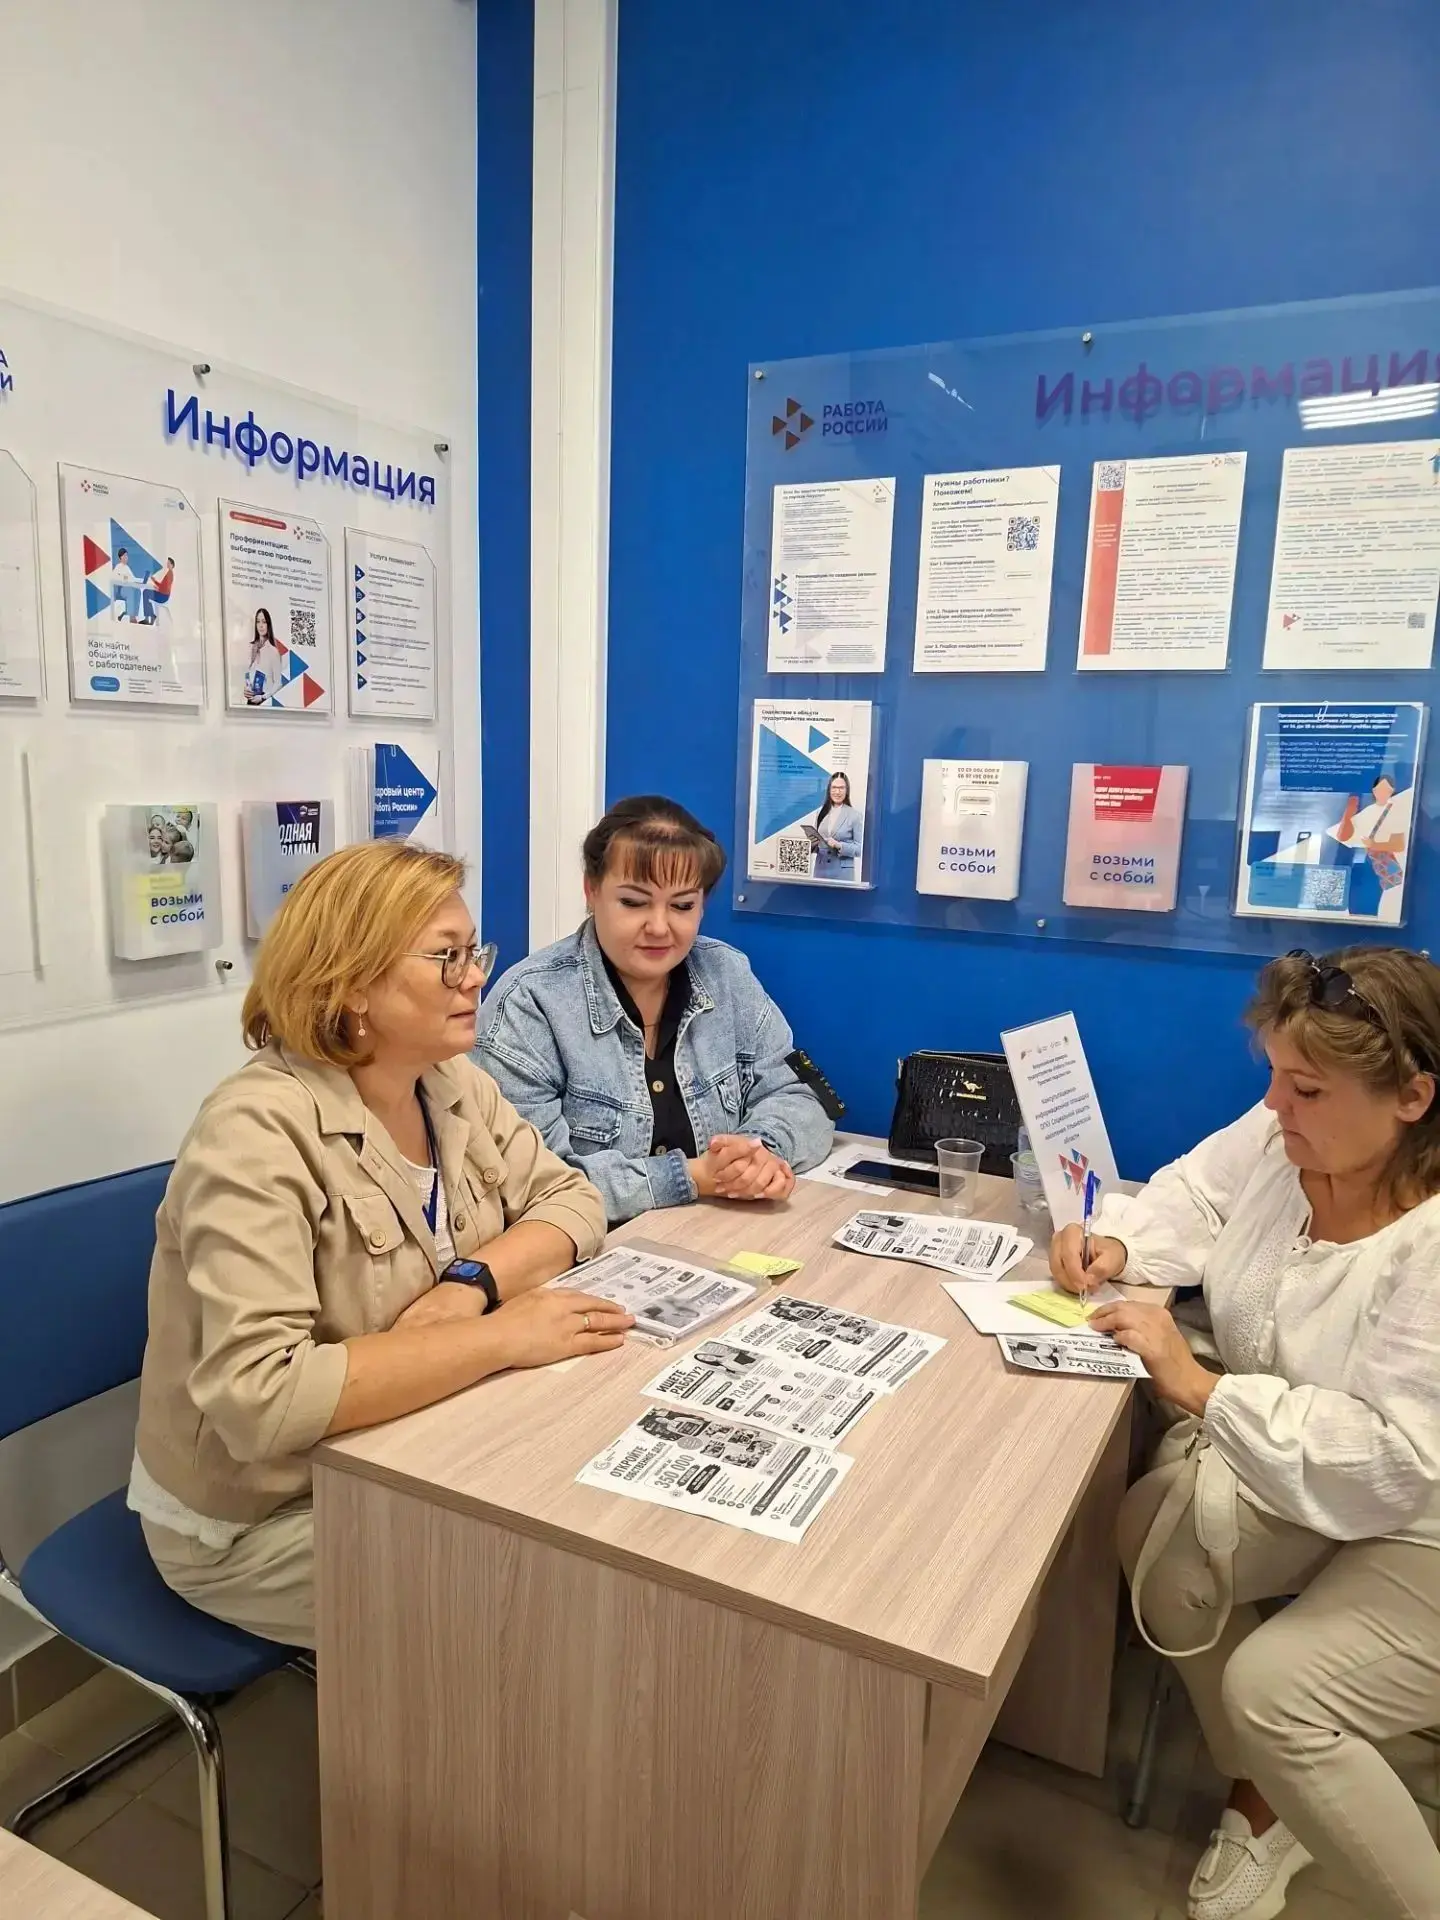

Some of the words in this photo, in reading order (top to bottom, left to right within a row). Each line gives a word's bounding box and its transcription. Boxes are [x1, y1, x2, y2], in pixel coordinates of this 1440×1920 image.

[1035, 348, 1440, 424] Информаци
[823, 400, 886, 419] РАБОТА
[822, 416, 888, 437] РОССИИ
[168, 389, 435, 505] Информация
[934, 480, 961, 488] Нужны
[963, 476, 1010, 486] работники?
[934, 488, 973, 496] Поможем!
[230, 532, 289, 550] Профориентация:
[230, 545, 256, 554] выбери
[258, 549, 275, 558] свою
[275, 553, 312, 565] профессию
[88, 639, 104, 648] Как
[105, 641, 130, 651] найти
[88, 650, 117, 659] общий
[119, 654, 139, 662] язык
[95, 660, 162, 672] работодателем?
[375, 785, 402, 798] дровый
[403, 787, 424, 798] центр
[392, 802, 418, 812] России»
[279, 822, 312, 843] ОДНАЯ
[941, 846, 995, 858] возьми
[938, 862, 946, 870] с
[1093, 855, 1154, 867] возьми
[1090, 872, 1098, 880] с
[1104, 871, 1154, 884] собой
[151, 894, 203, 908] возьми
[150, 916, 158, 925] с
[162, 907, 205, 923] собой
[656, 1369, 686, 1393] ИЩЕТЕ
[670, 1366, 705, 1395] РАБОТУ?
[609, 1445, 648, 1478] ОТКРОЙТЕ
[654, 1470, 680, 1488] 350
[671, 1454, 695, 1472] 000
